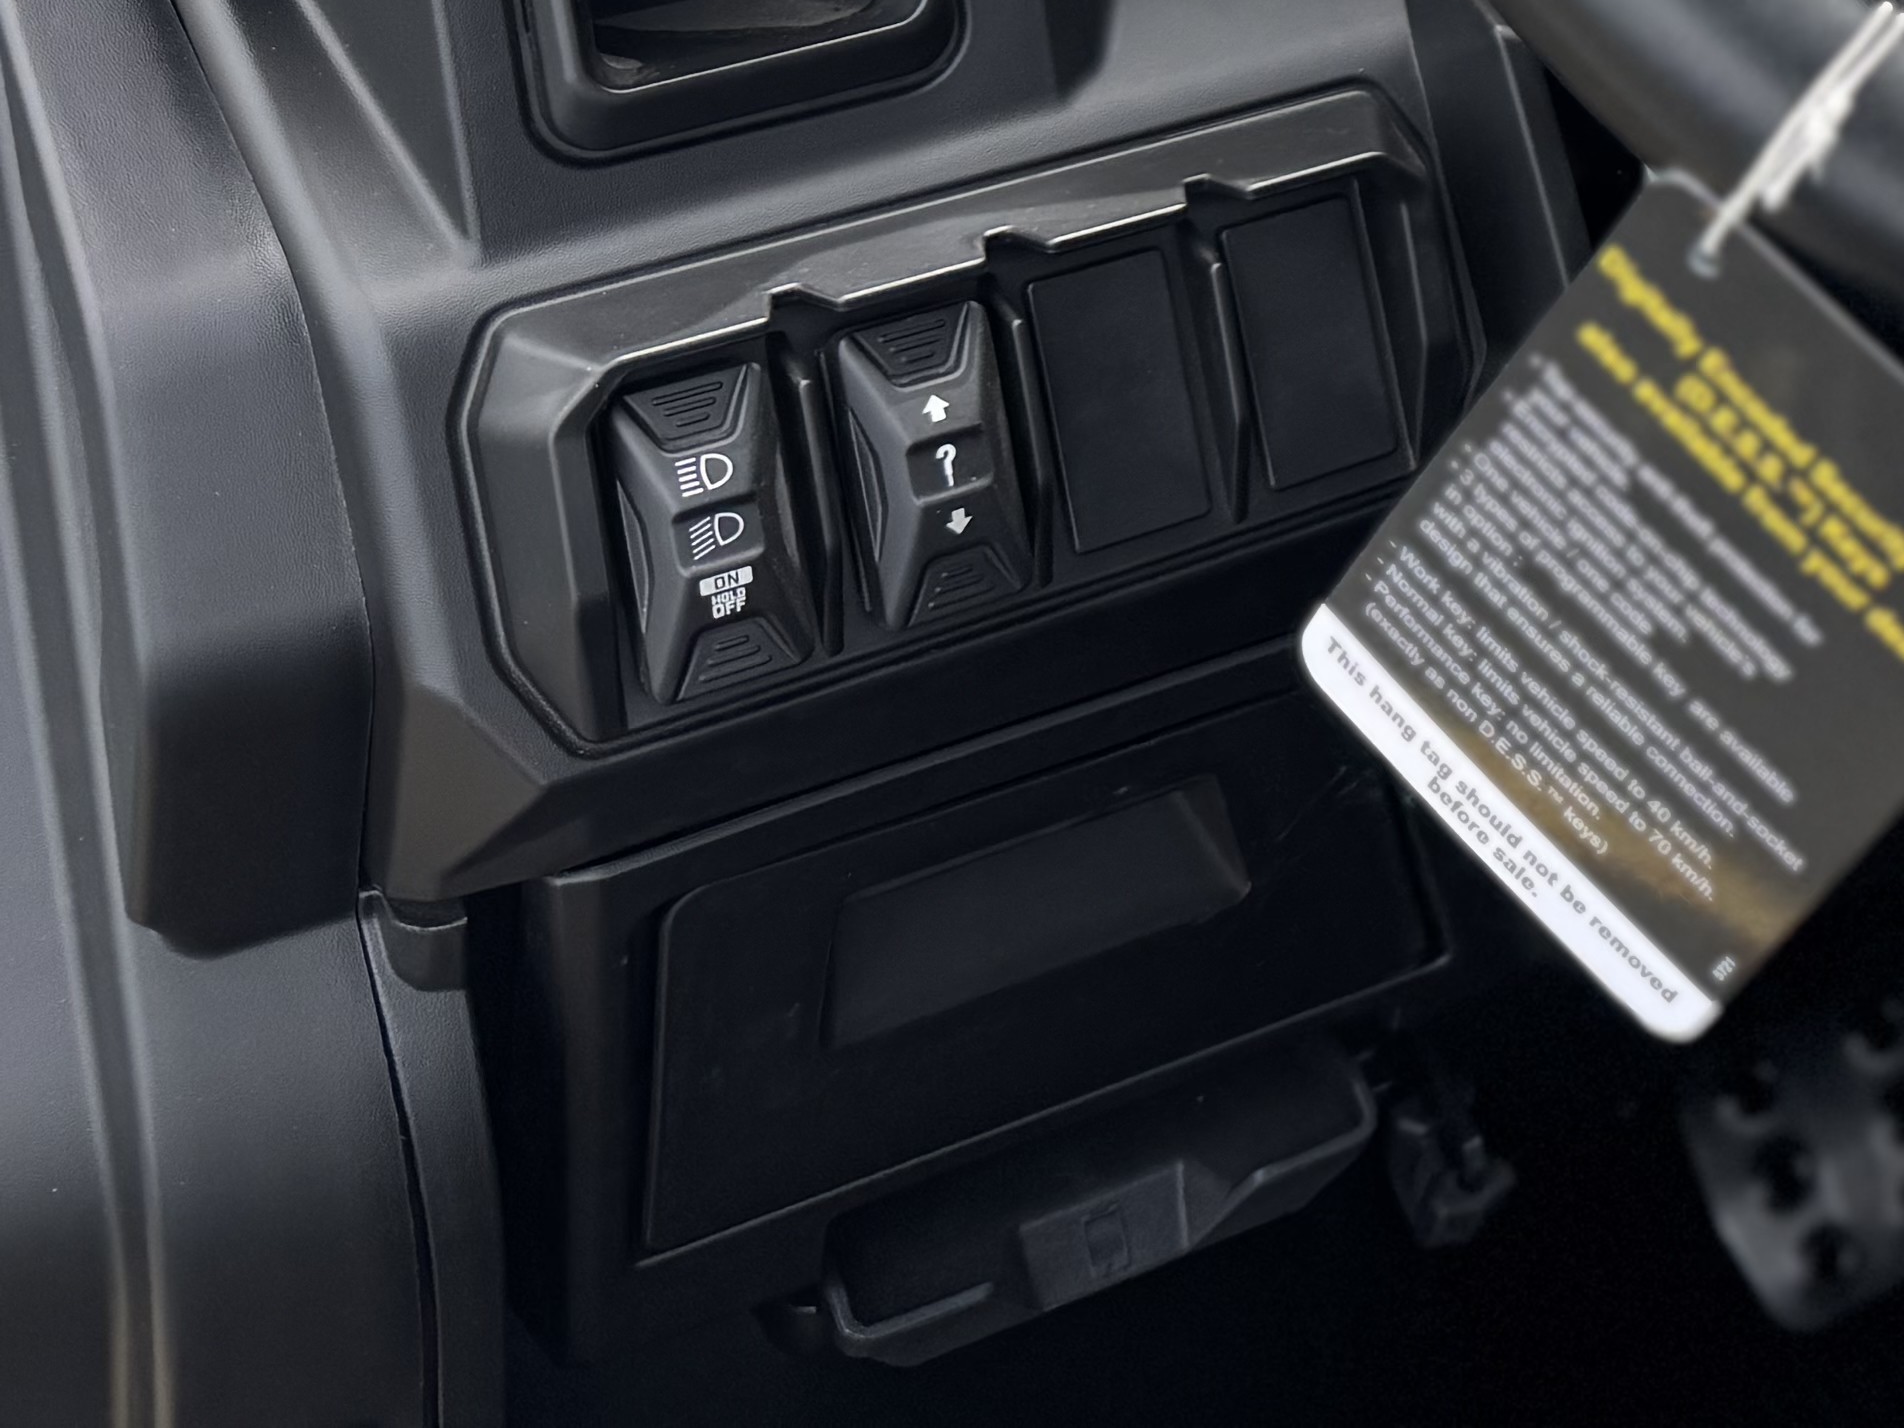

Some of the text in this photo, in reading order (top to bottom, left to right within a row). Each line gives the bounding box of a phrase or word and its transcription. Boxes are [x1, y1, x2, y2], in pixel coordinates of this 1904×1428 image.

[1525, 382, 1571, 432] your
[1573, 315, 1642, 389] also
[1629, 371, 1752, 497] available
[1737, 480, 1813, 558] from
[1796, 543, 1874, 622] your
[1591, 242, 1710, 365] Digitally
[1693, 342, 1821, 472] Encoded
[712, 597, 746, 619] OFF
[714, 571, 740, 590] ON
[1460, 500, 1515, 559] option
[1471, 451, 1511, 493] One
[1507, 488, 1568, 551] vehicle
[1575, 557, 1610, 594] one
[1608, 589, 1654, 637] code
[1486, 436, 1692, 647] electronic ignition system.
[1500, 420, 1569, 492] restricts
[1565, 487, 1626, 550] access
[1641, 564, 1683, 608] your
[1508, 399, 1598, 491] Encrypted
[1695, 584, 1794, 685] technology
[1704, 529, 1798, 625] protection
[1787, 608, 1828, 651] for
[1812, 511, 1895, 595] Keys
[1361, 599, 1427, 670] (exactly
[1445, 686, 1479, 723] non
[1560, 804, 1611, 858] keys)
[1372, 579, 1474, 686] Performance
[1468, 681, 1507, 723] key:
[1527, 739, 1606, 821] limitation.
[1384, 562, 1445, 627] Normal
[1439, 622, 1479, 665] key:
[1476, 657, 1523, 707] limits
[1519, 700, 1580, 764] vehicle
[1574, 758, 1630, 817] speed
[1669, 850, 1720, 903] km/h.
[1396, 545, 1442, 595] Work
[1437, 589, 1477, 633] key:
[1475, 625, 1521, 674] limits
[1517, 668, 1578, 732] vehicle
[1573, 726, 1629, 785] speed
[1668, 818, 1719, 871] km/h.
[1416, 515, 1475, 579] design
[1472, 570, 1508, 609] that
[1505, 604, 1572, 674] ensures
[1584, 682, 1647, 747] reliable
[1644, 741, 1741, 840] connection.
[1430, 499, 1468, 540] with
[1480, 549, 1551, 623] vibration
[1557, 625, 1681, 752] shock-resistant
[1677, 744, 1807, 876] ball-and-socket
[1470, 483, 1520, 535] types
[1533, 546, 1654, 669] programmable
[1649, 661, 1687, 701] key
[1687, 698, 1721, 732] are
[1717, 725, 1797, 806] available
[1322, 635, 1370, 688] This
[1365, 684, 1420, 744] hang
[1416, 738, 1455, 782] tag
[1454, 776, 1523, 850] should
[1522, 845, 1561, 888] not
[1588, 911, 1678, 1005] removed
[1425, 774, 1544, 899] before sale.
